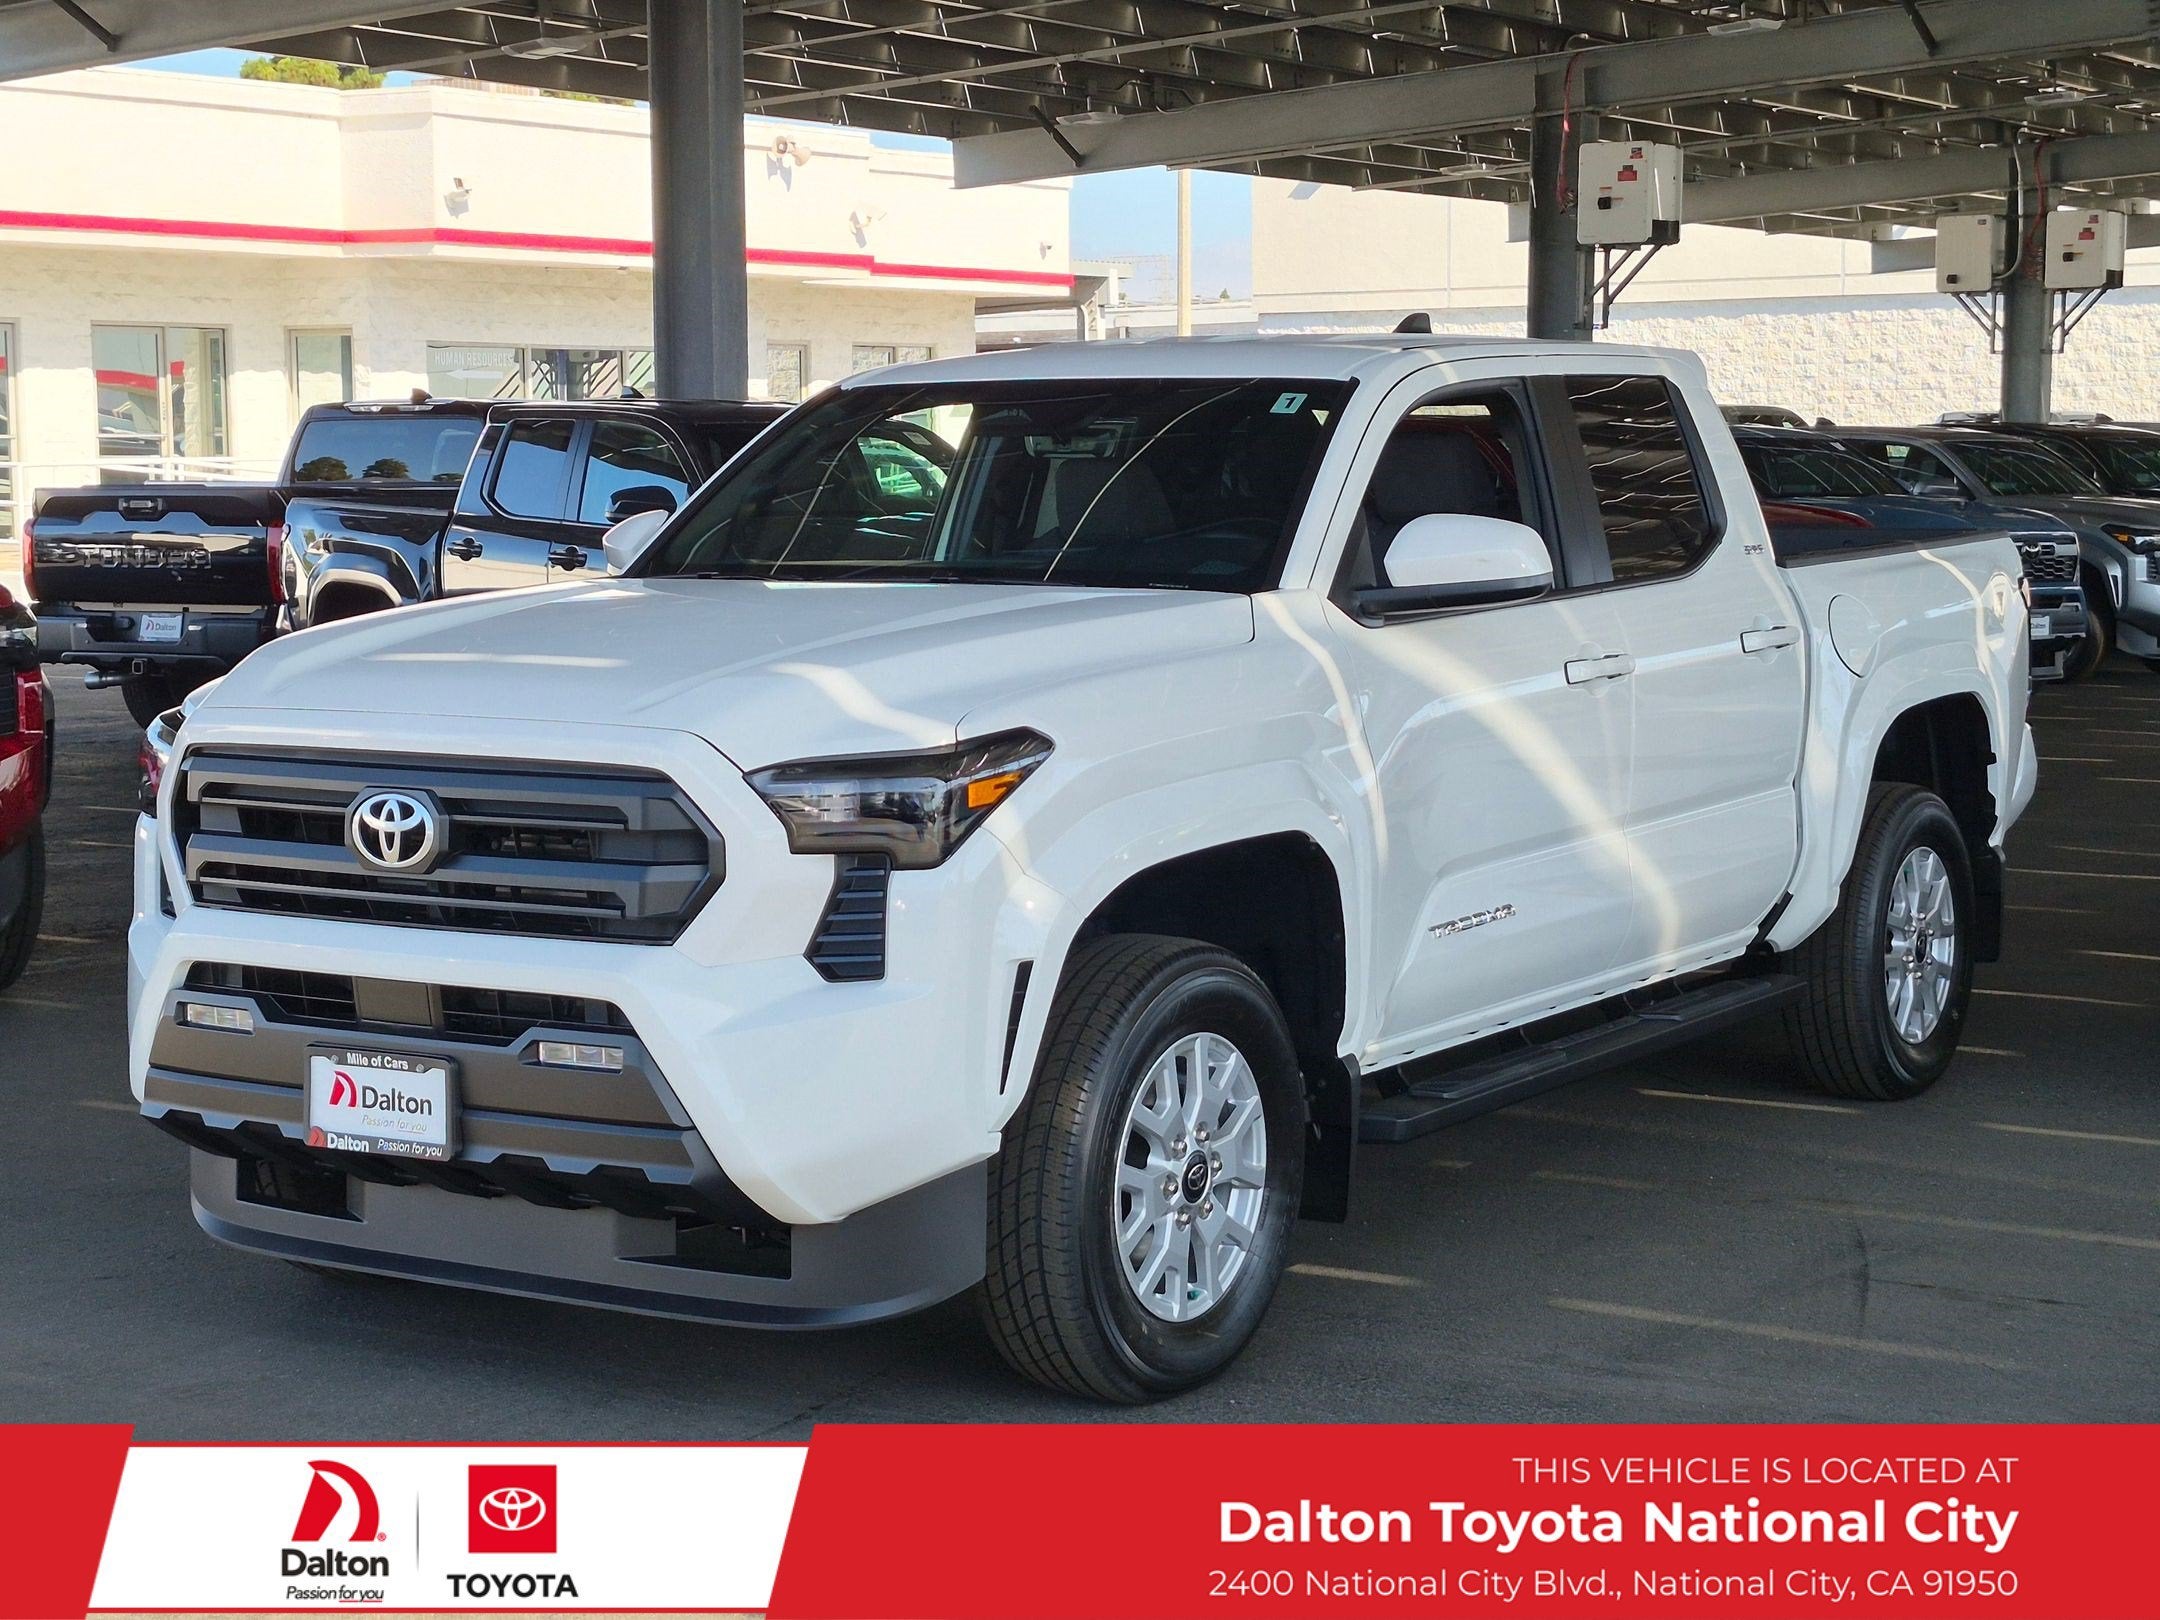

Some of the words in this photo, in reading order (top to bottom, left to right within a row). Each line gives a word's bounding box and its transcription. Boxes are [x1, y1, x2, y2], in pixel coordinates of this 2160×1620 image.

[434, 351, 465, 368] HUMAN
[466, 352, 515, 367] RESOURCES
[1285, 396, 1297, 409] 1
[76, 548, 212, 568] TUNDRA
[155, 623, 176, 631] Dalton
[1428, 903, 1516, 937] TACOMA
[346, 1052, 369, 1065] Mile
[371, 1055, 382, 1067] of
[383, 1057, 409, 1070] Cars
[361, 1085, 432, 1116] Dalton
[361, 1114, 395, 1129] Passion
[397, 1119, 409, 1130] for
[410, 1123, 427, 1132] you
[327, 1133, 370, 1152] Dalton
[377, 1138, 410, 1154] Passion
[411, 1142, 425, 1155] for
[425, 1147, 443, 1157] you
